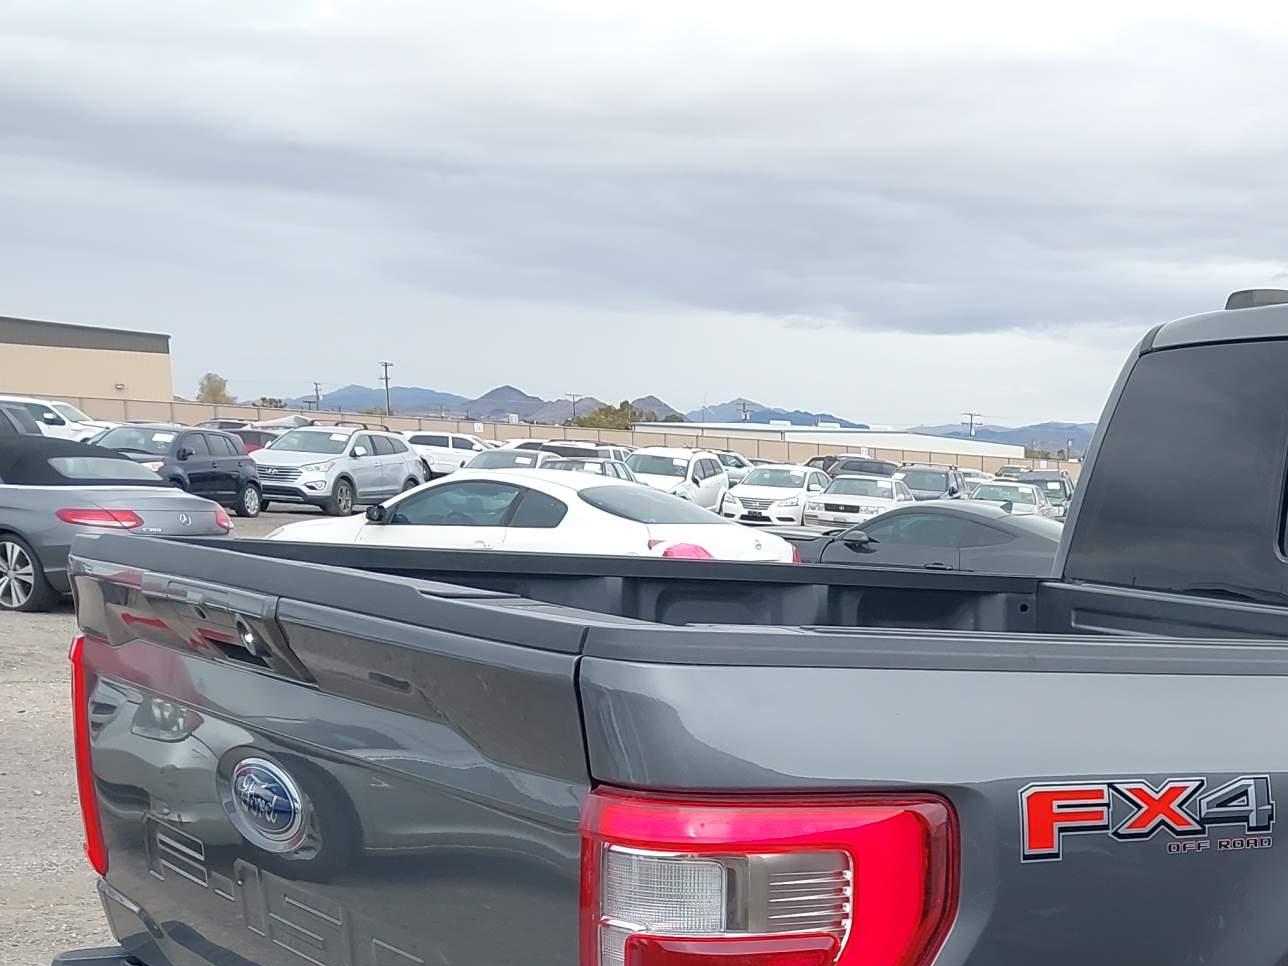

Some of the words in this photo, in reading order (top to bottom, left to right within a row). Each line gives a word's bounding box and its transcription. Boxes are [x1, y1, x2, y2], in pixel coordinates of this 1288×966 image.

[1018, 774, 1276, 863] FX4
[1167, 840, 1211, 854] OFF
[1217, 836, 1273, 851] ROAD
